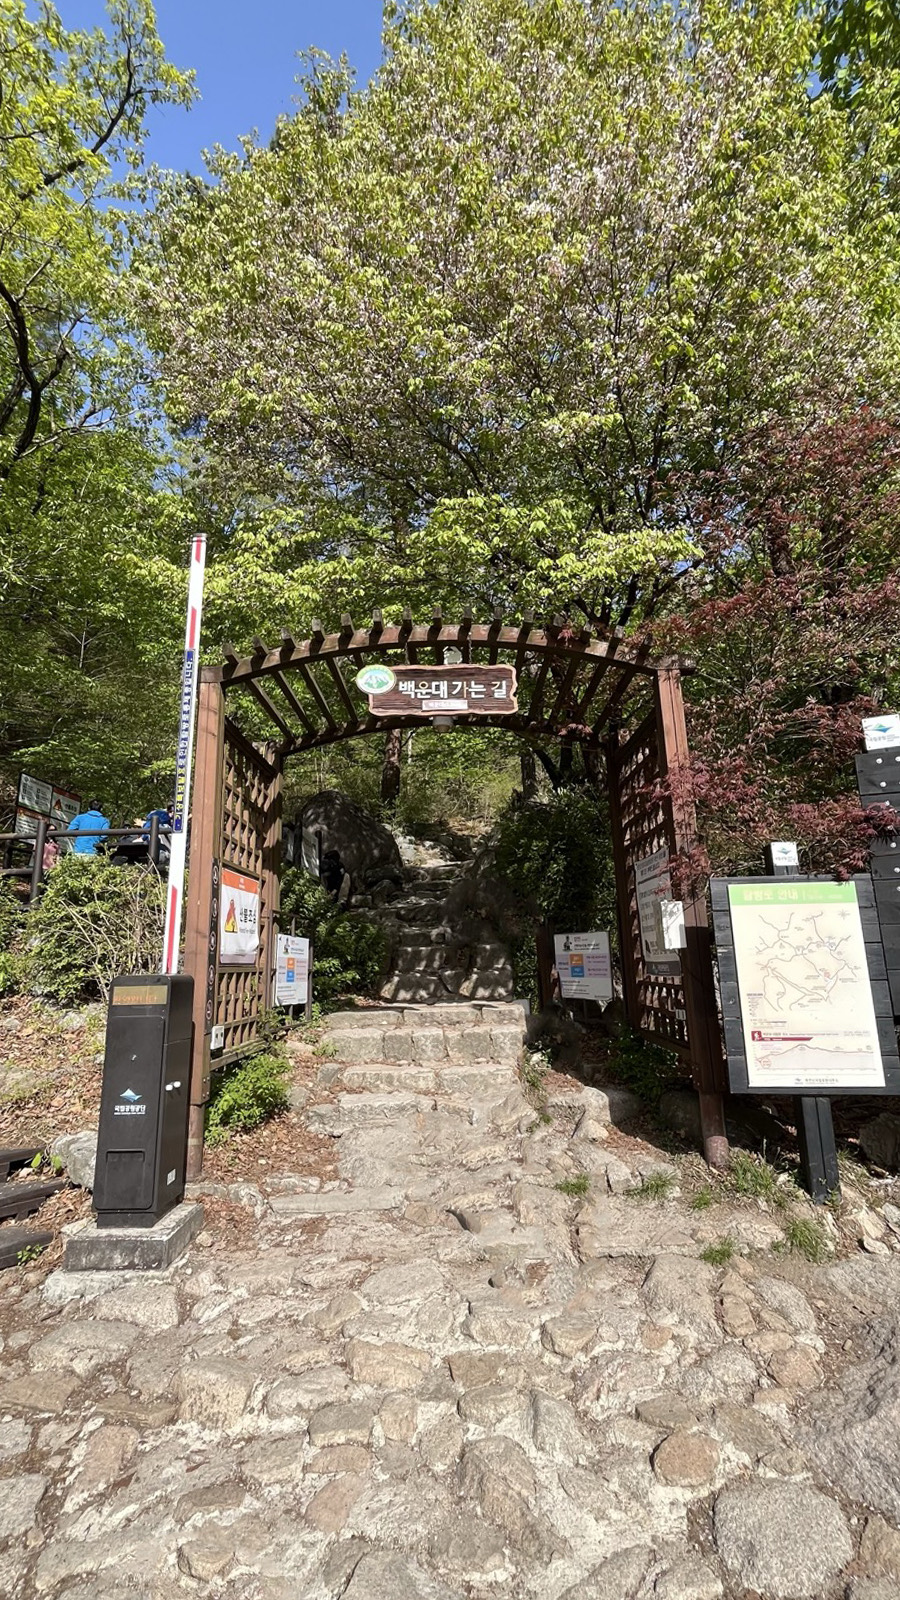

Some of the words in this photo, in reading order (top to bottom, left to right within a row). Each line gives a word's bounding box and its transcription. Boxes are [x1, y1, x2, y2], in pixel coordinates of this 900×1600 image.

[399, 680, 448, 699] 백운대
[451, 681, 486, 699] 가는
[491, 680, 507, 699] 길
[777, 888, 799, 900] 안내
